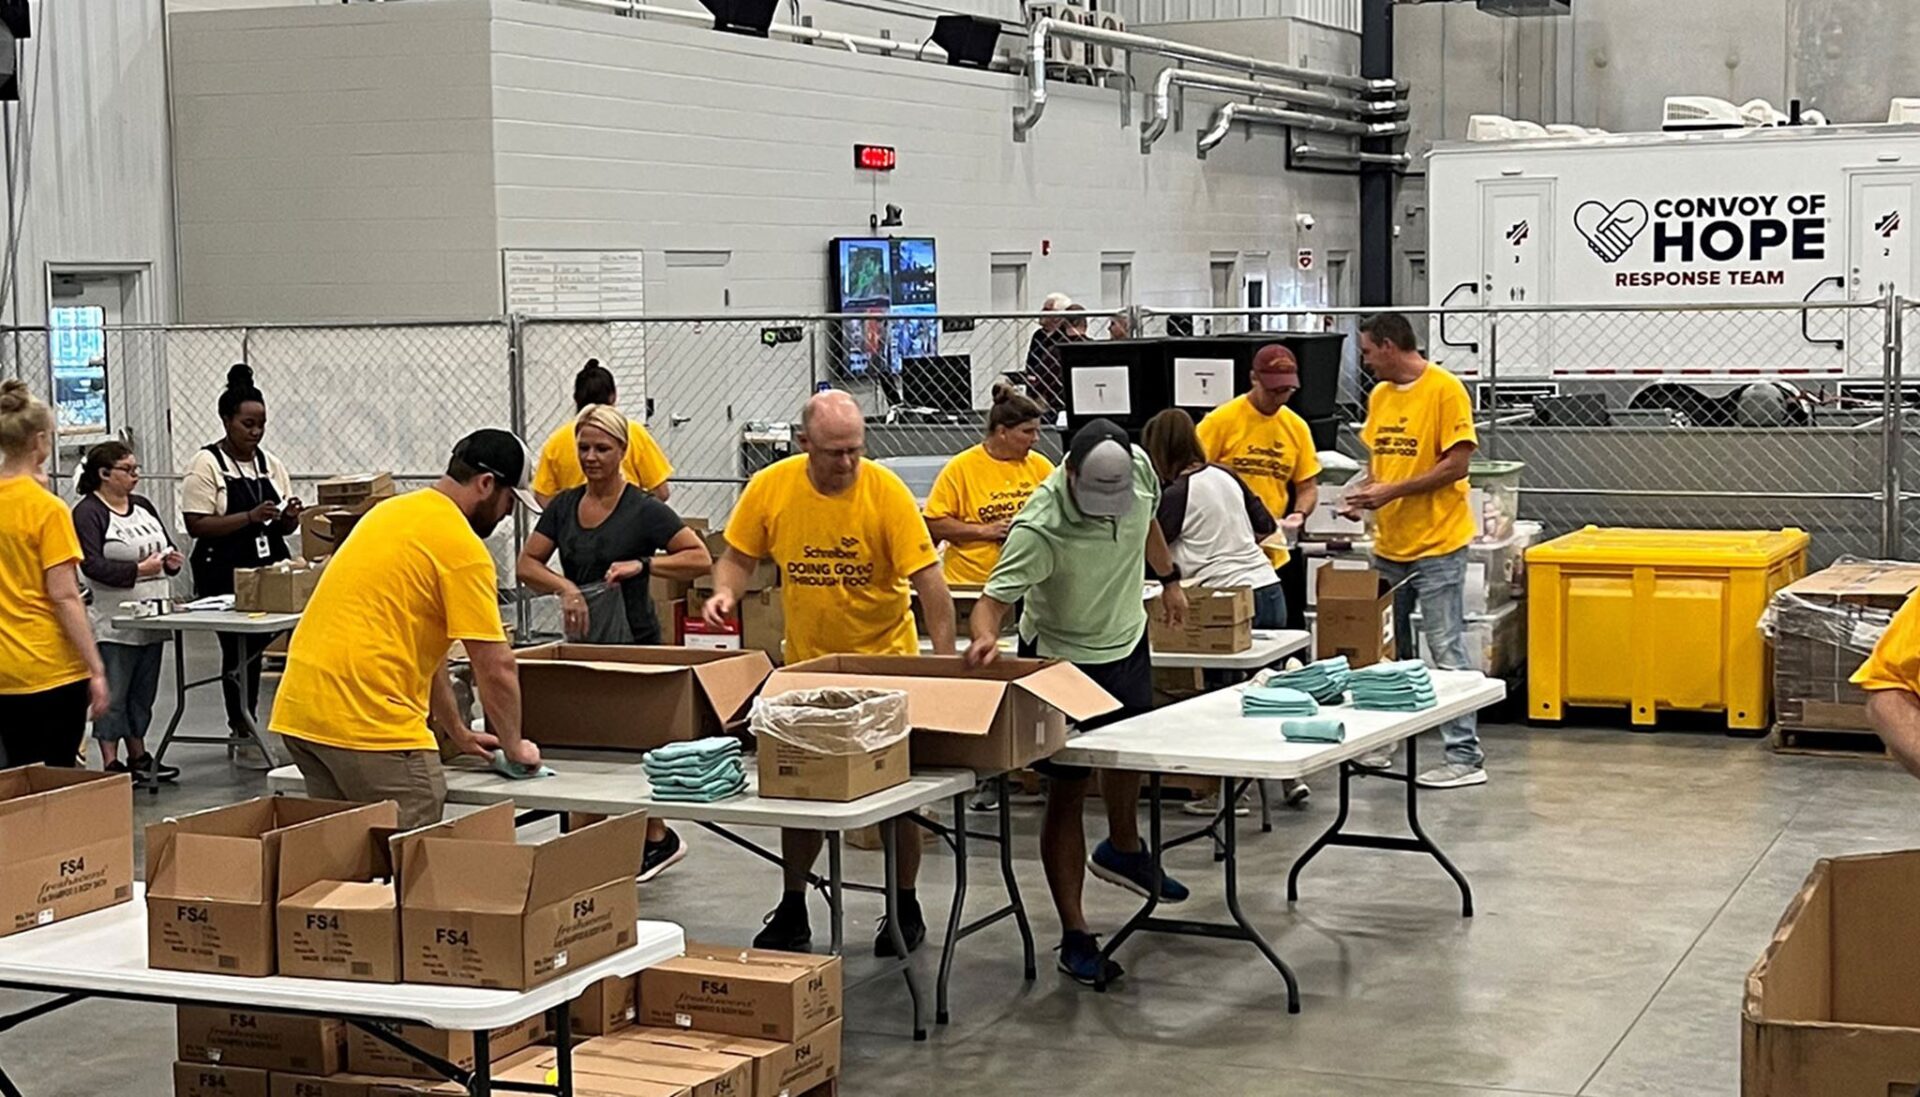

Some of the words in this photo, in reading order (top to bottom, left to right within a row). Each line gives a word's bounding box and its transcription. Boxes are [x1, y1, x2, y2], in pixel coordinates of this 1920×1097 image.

[1654, 196, 1778, 218] CONVOY
[1787, 195, 1825, 215] OF
[1654, 218, 1825, 262] HOPE
[1615, 271, 1721, 287] RESPONSE
[1728, 271, 1784, 285] TEAM
[979, 502, 1014, 515] DOING
[804, 545, 858, 559] Schreiber
[787, 562, 831, 575] DOING
[790, 575, 839, 587] THROUGH
[60, 856, 84, 876] FS4
[177, 905, 209, 923] FS4
[573, 897, 594, 919] FS4
[306, 914, 339, 930] FS4
[436, 928, 469, 946] FS4
[701, 981, 728, 995] FS4
[229, 1013, 257, 1029] FS4
[200, 1073, 226, 1088] FS4
